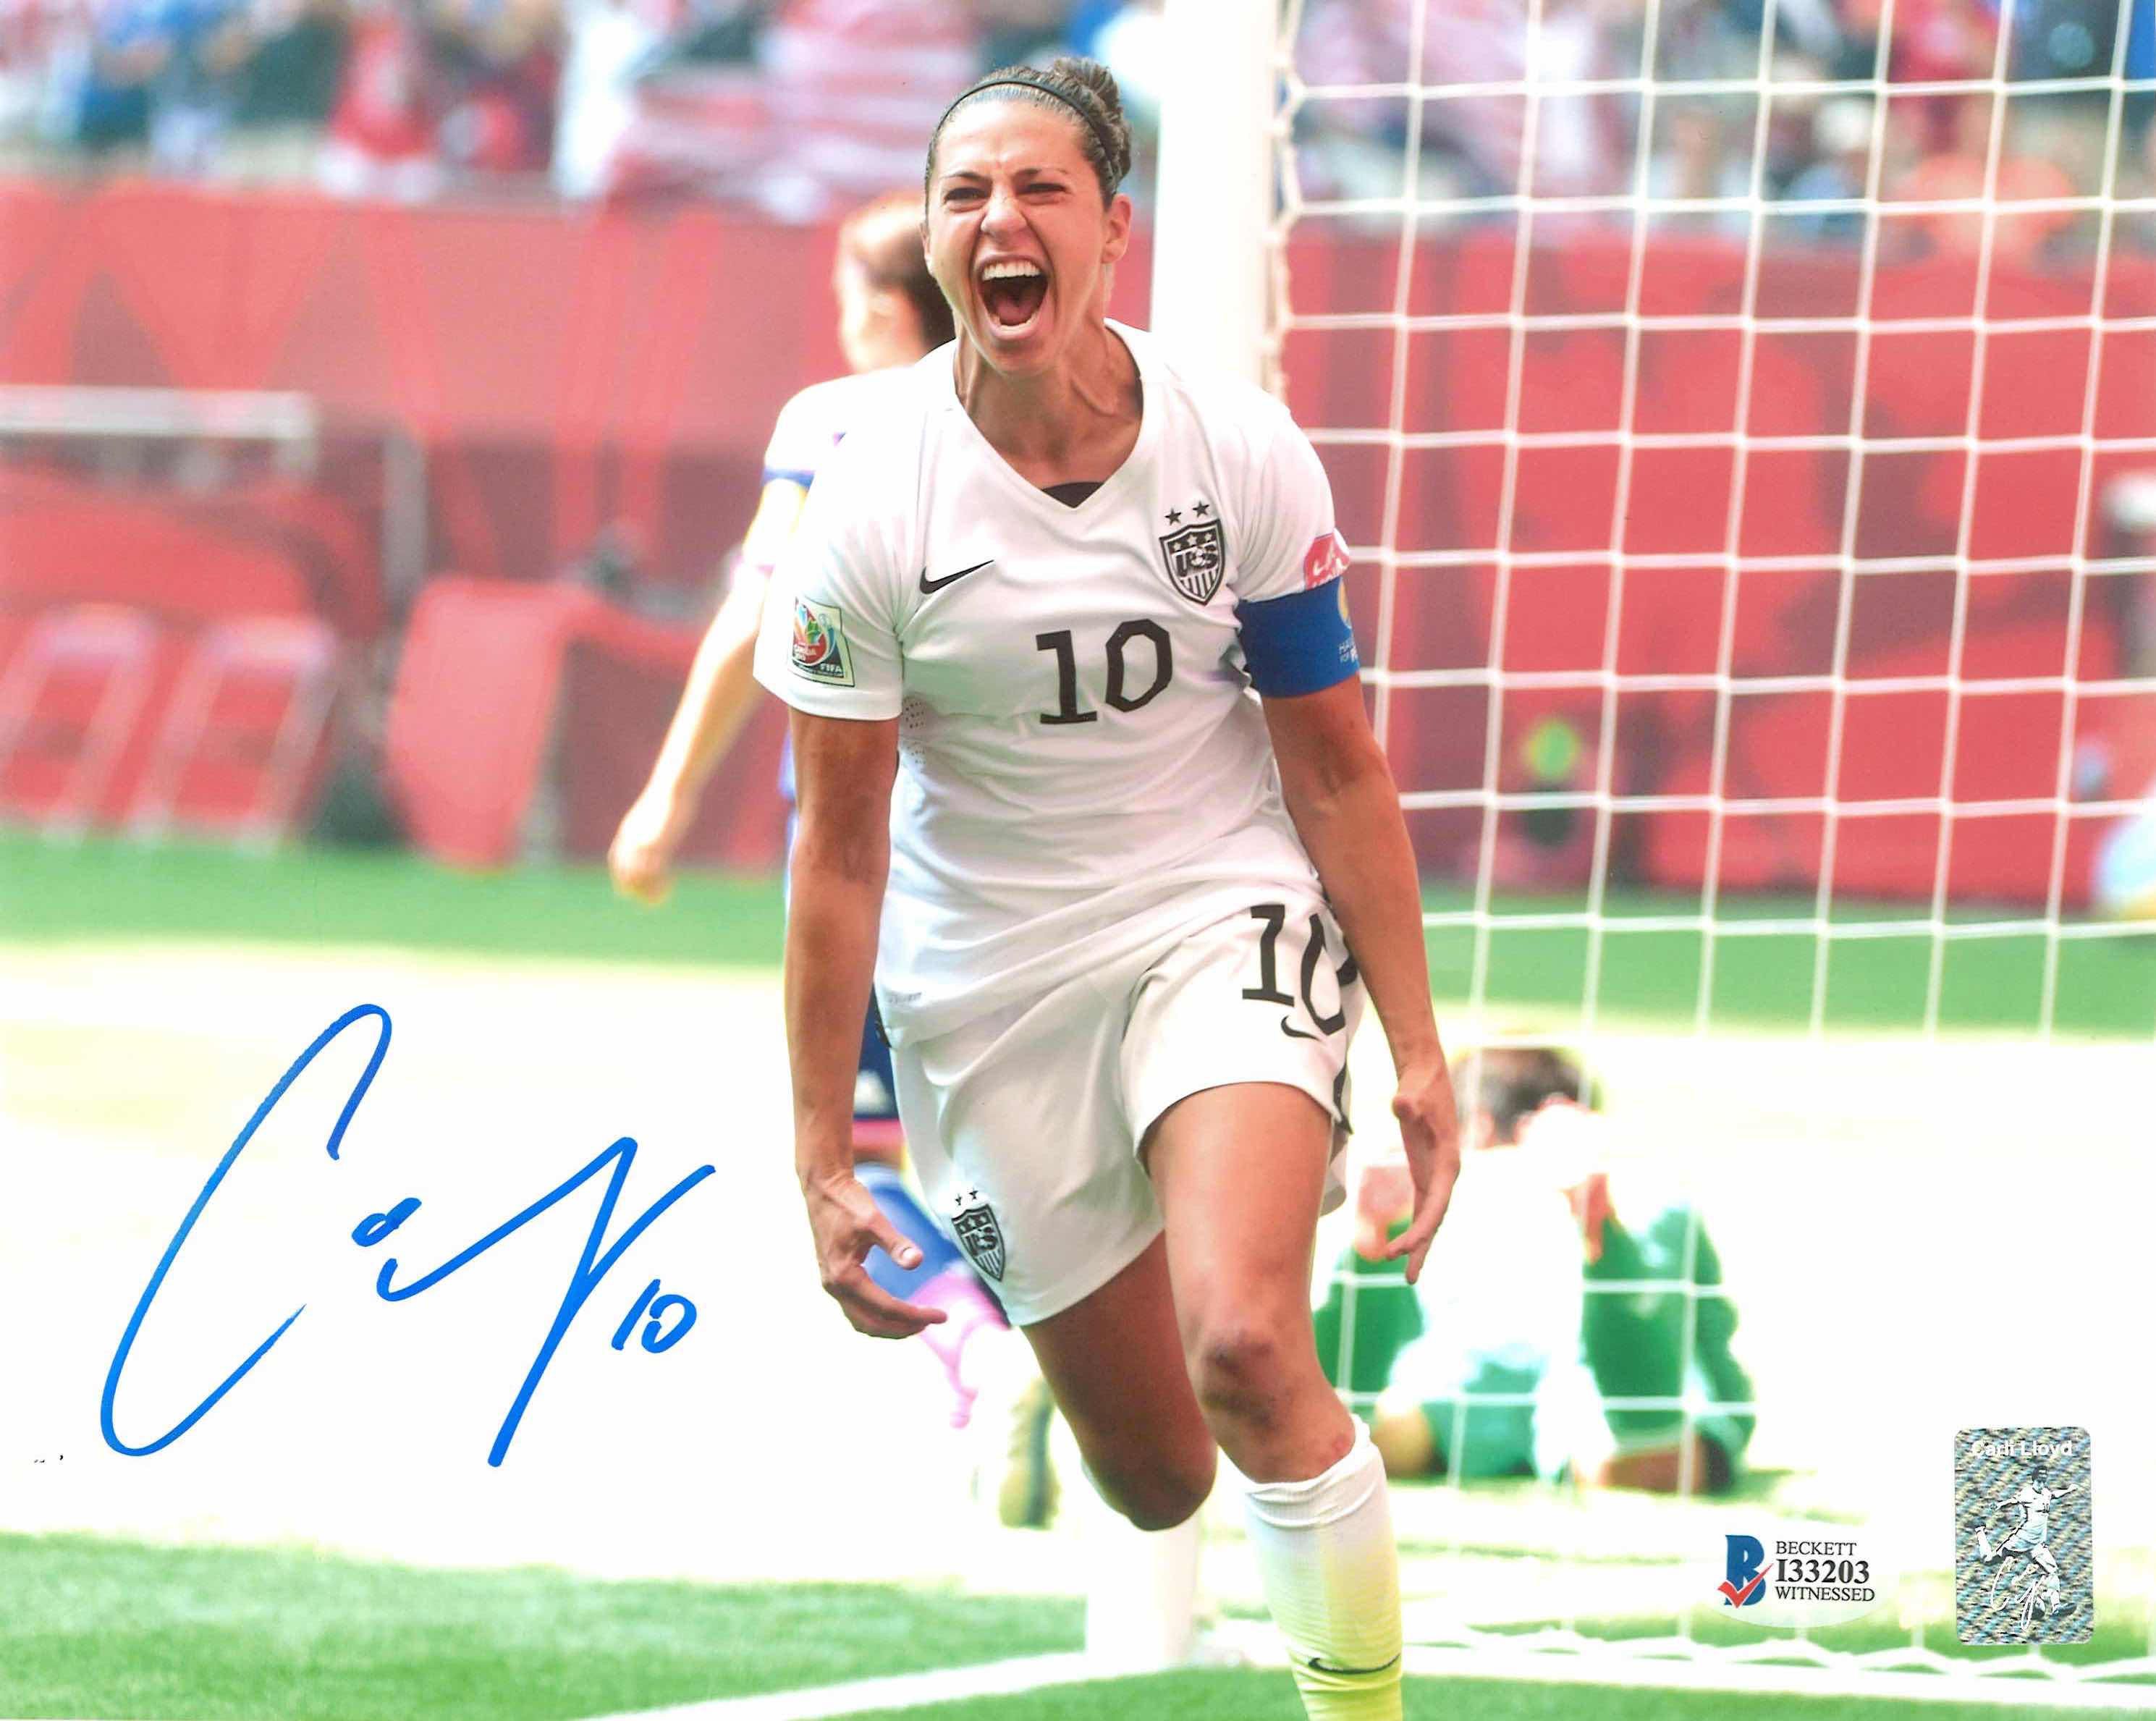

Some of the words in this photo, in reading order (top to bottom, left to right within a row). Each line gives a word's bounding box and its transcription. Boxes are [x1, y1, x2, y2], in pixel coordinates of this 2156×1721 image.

[820, 663, 843, 672] FIFA
[1036, 619, 1173, 724] 10
[1242, 904, 1358, 1036] 10
[612, 1279, 698, 1353] 10
[2021, 1439, 2072, 1457] Lloyd
[1775, 1541, 1857, 1556] BECKETT
[1775, 1559, 1869, 1584] I33203
[1775, 1586, 1875, 1602] WITNESSED
